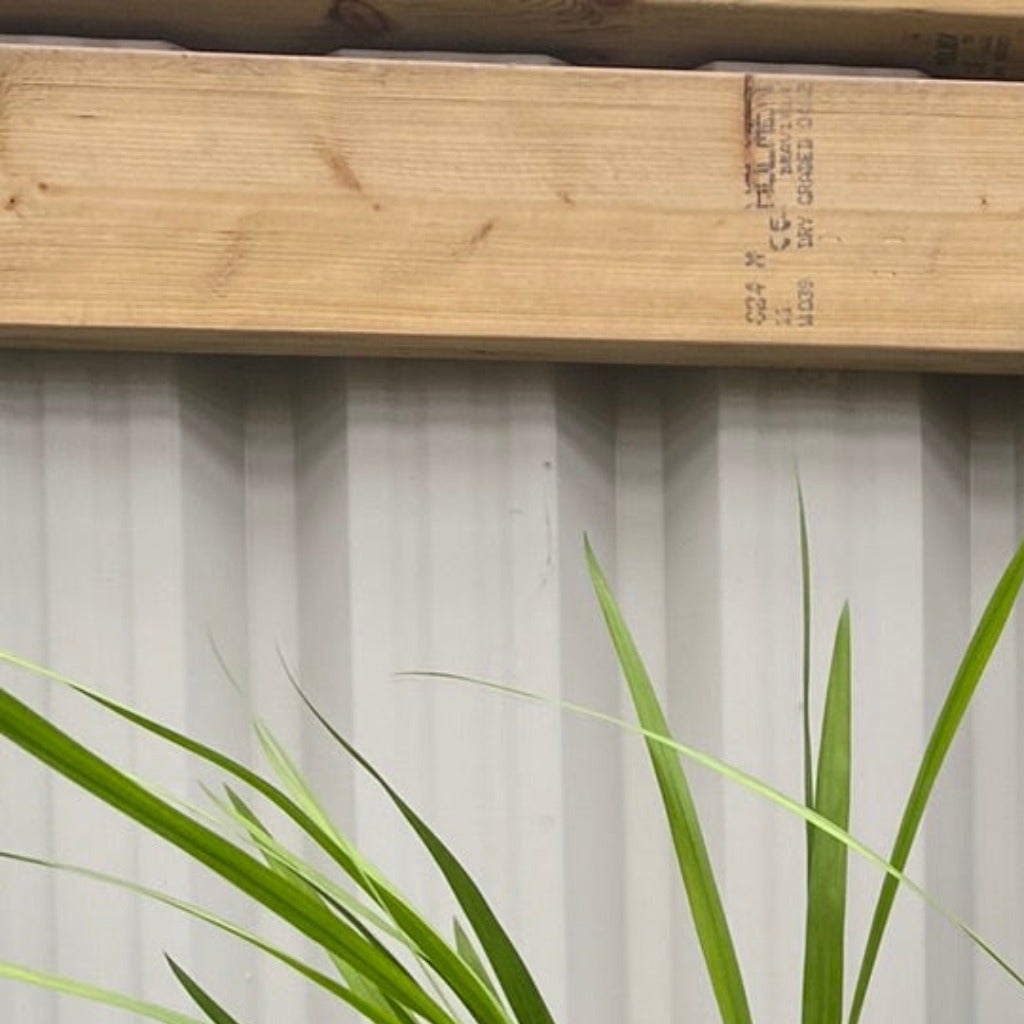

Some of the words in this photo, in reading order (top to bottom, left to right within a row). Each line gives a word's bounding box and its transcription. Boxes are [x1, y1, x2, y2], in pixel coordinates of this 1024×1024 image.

[796, 138, 814, 206] GRADED
[769, 214, 791, 251] CE
[796, 215, 814, 249] DRY
